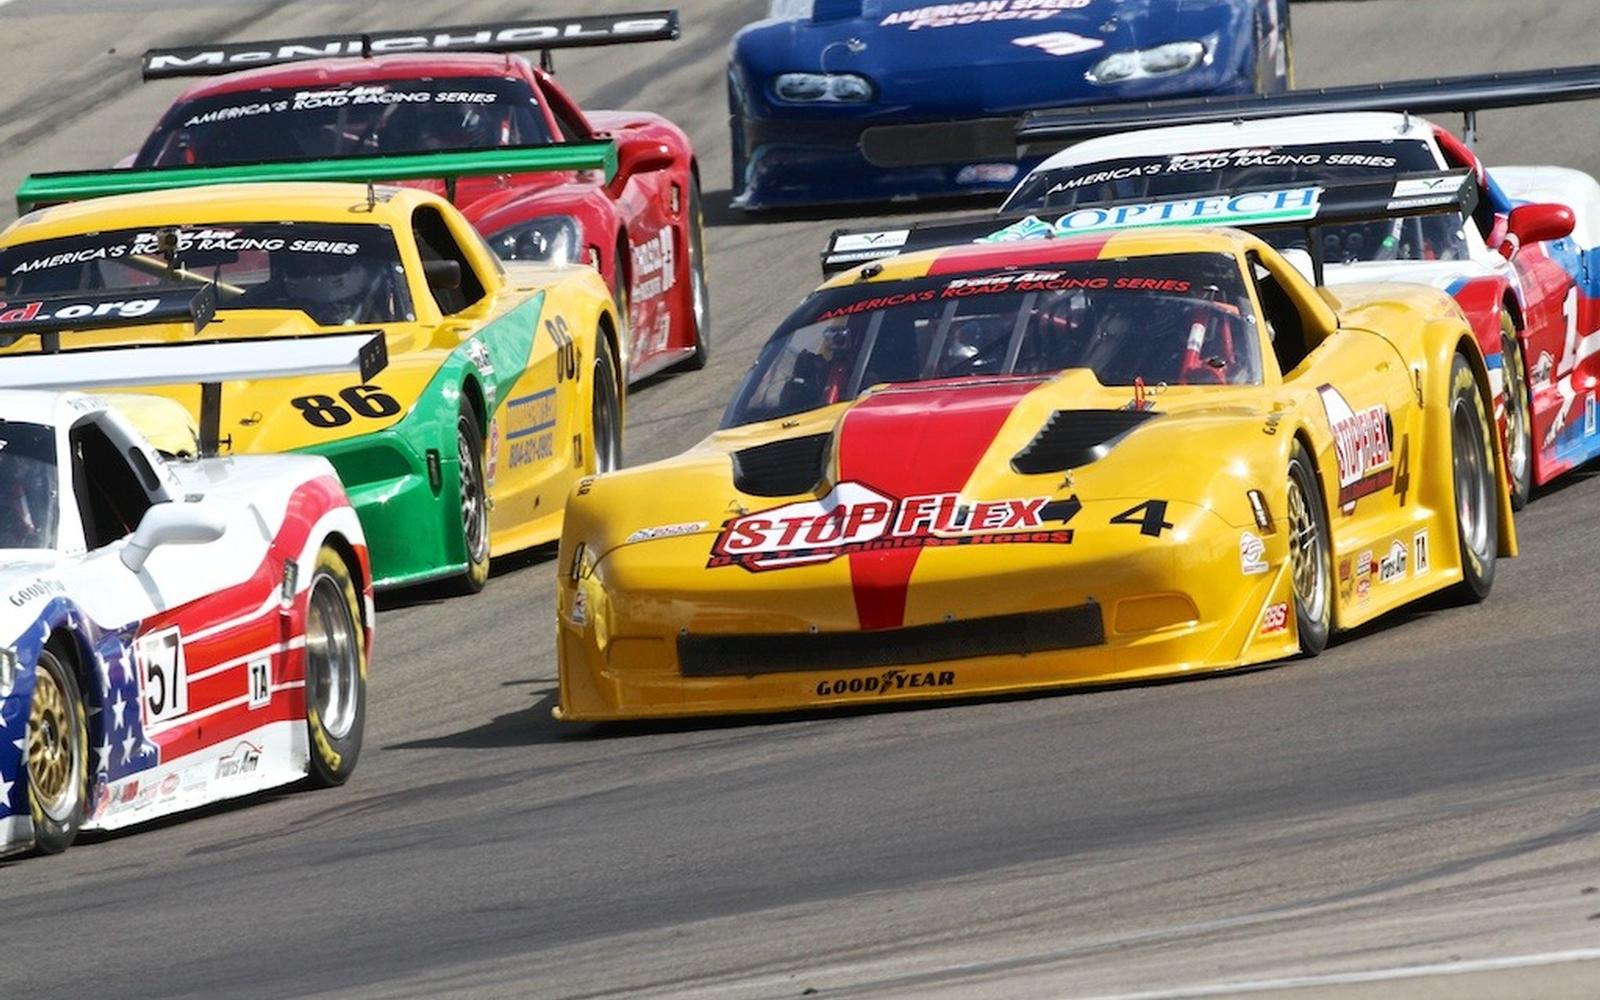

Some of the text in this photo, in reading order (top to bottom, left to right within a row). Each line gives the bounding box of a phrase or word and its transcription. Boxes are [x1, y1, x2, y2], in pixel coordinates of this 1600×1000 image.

[879, 0, 1008, 26] AMERICAN
[184, 92, 497, 127] AMERICA'S ROAD RACING SERIES
[1047, 154, 1397, 194] AMERICA'S ROAD RACING SERIES
[1061, 188, 1315, 229] OPTECH
[12, 238, 359, 276] AMERICA'S ROD RACING SERIES
[0, 299, 162, 323] d.org
[817, 278, 1191, 321] AMERICA'S ROAD RACING SERIES
[545, 315, 576, 384] 86
[290, 385, 402, 428] 86
[1394, 433, 1410, 508] 4
[728, 502, 888, 549] STOP
[898, 494, 1047, 533] FLEX
[1109, 499, 1174, 537] 4
[1415, 535, 1427, 572] TA
[148, 632, 180, 716] 57
[251, 664, 268, 701] TA
[816, 670, 956, 696] GOODYEAR
